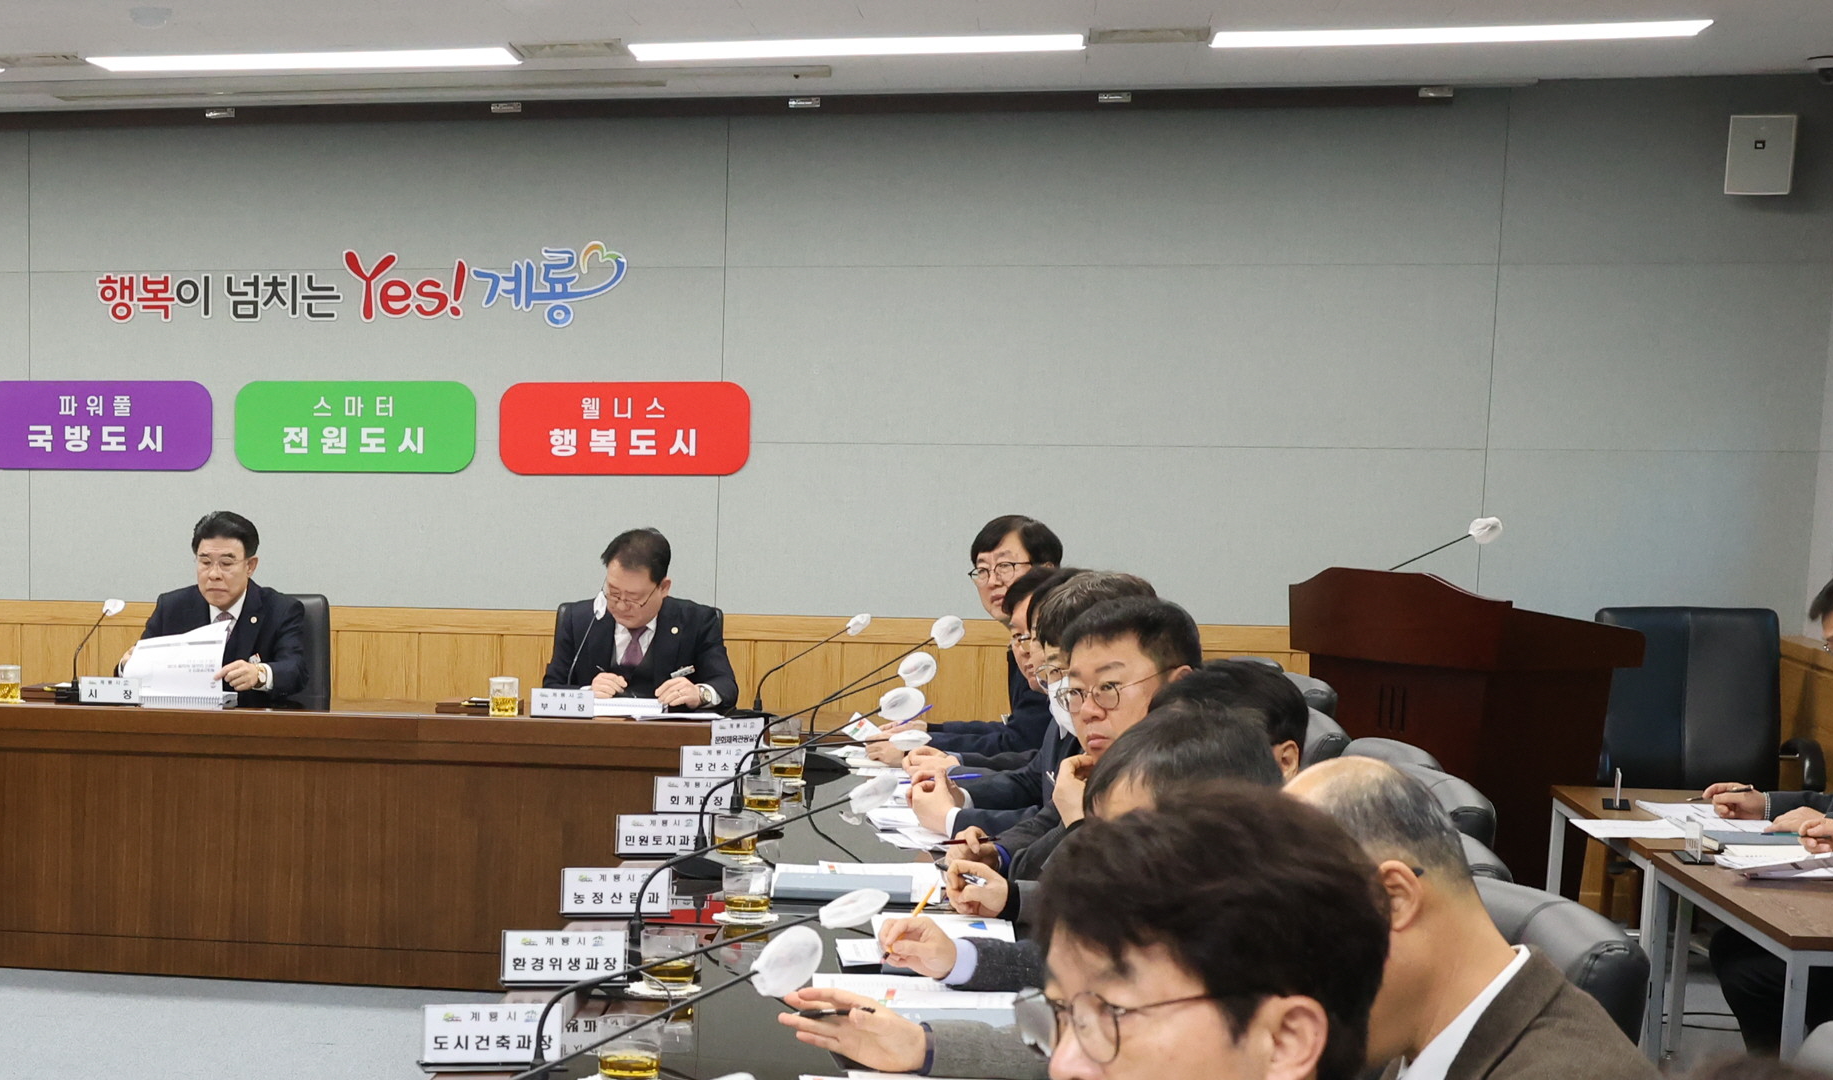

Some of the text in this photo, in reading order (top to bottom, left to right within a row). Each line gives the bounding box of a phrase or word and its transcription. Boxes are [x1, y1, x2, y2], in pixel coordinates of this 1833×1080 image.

[97, 246, 622, 327] 행복이 넘치는 Yes! 계룡
[58, 395, 132, 417] 파워풀
[313, 396, 395, 418] 스마터
[581, 397, 665, 420] 웰니스
[27, 425, 163, 453] 국방도시
[283, 426, 425, 454] 전원도시
[549, 428, 696, 457] 행복도시
[541, 703, 585, 712] 부시장
[598, 873, 635, 882] 계룡시
[545, 936, 586, 947] 계룡시
[512, 957, 617, 971] 환경위생과장
[470, 1011, 517, 1022] 계룡시
[433, 1034, 553, 1051] 도시건축과장
